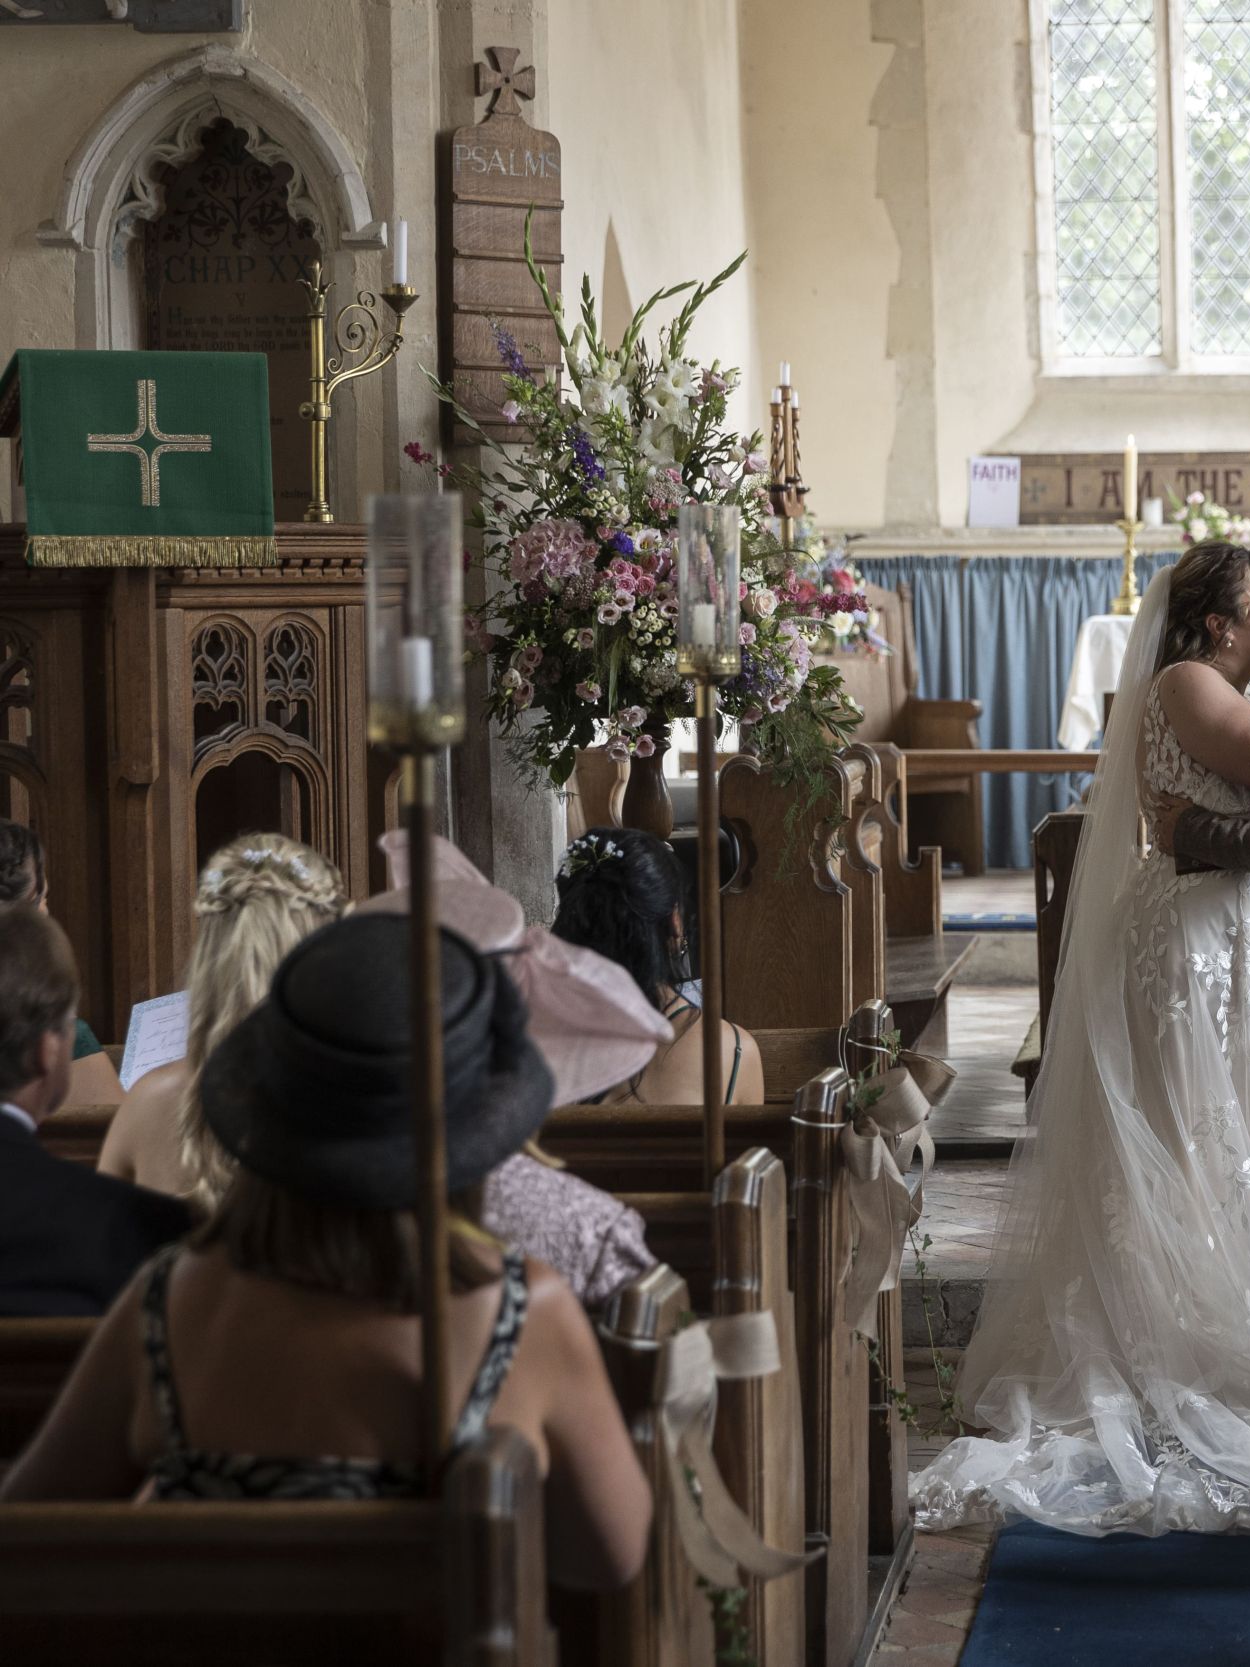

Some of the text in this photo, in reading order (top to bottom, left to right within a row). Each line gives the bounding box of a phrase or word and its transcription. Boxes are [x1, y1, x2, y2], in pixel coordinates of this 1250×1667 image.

[455, 144, 560, 178] PSALMS
[972, 463, 1017, 481] FAITH
[1064, 468, 1073, 507] I
[1176, 468, 1243, 506] THE
